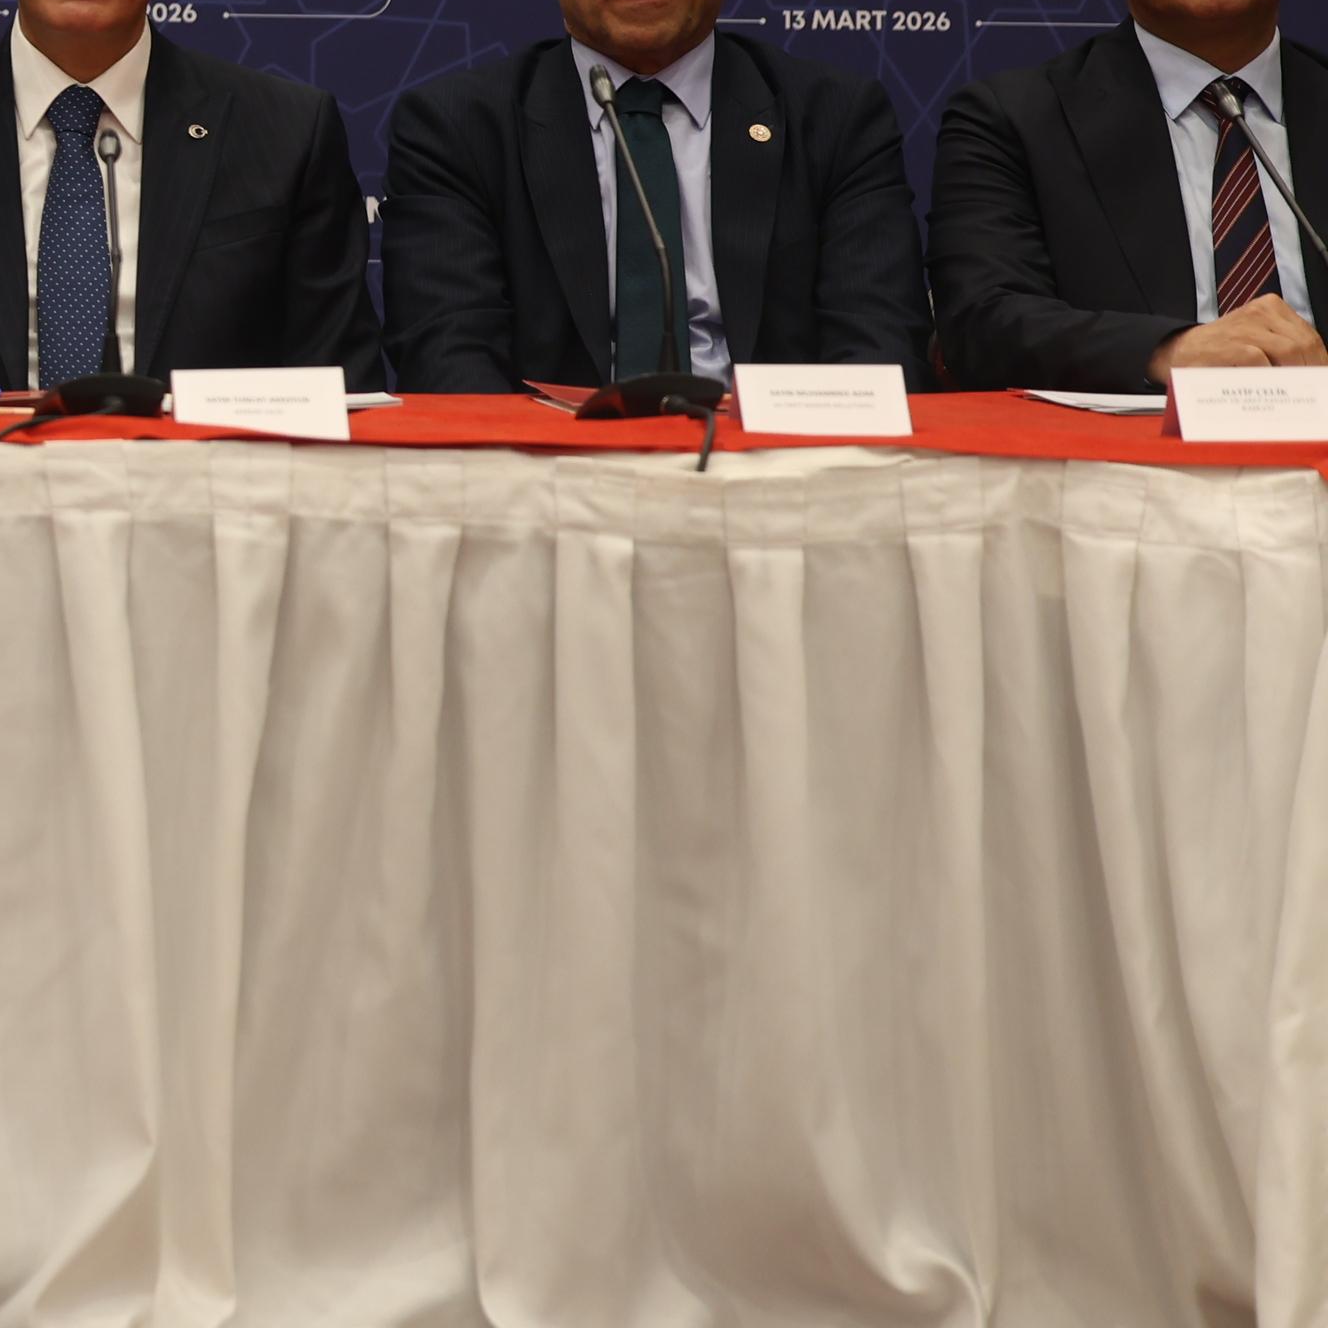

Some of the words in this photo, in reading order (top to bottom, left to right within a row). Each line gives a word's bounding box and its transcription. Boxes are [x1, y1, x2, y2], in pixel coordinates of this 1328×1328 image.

[145, 3, 197, 23] 026
[782, 10, 806, 30] 13
[811, 9, 887, 30] MART
[893, 11, 951, 31] 2026
